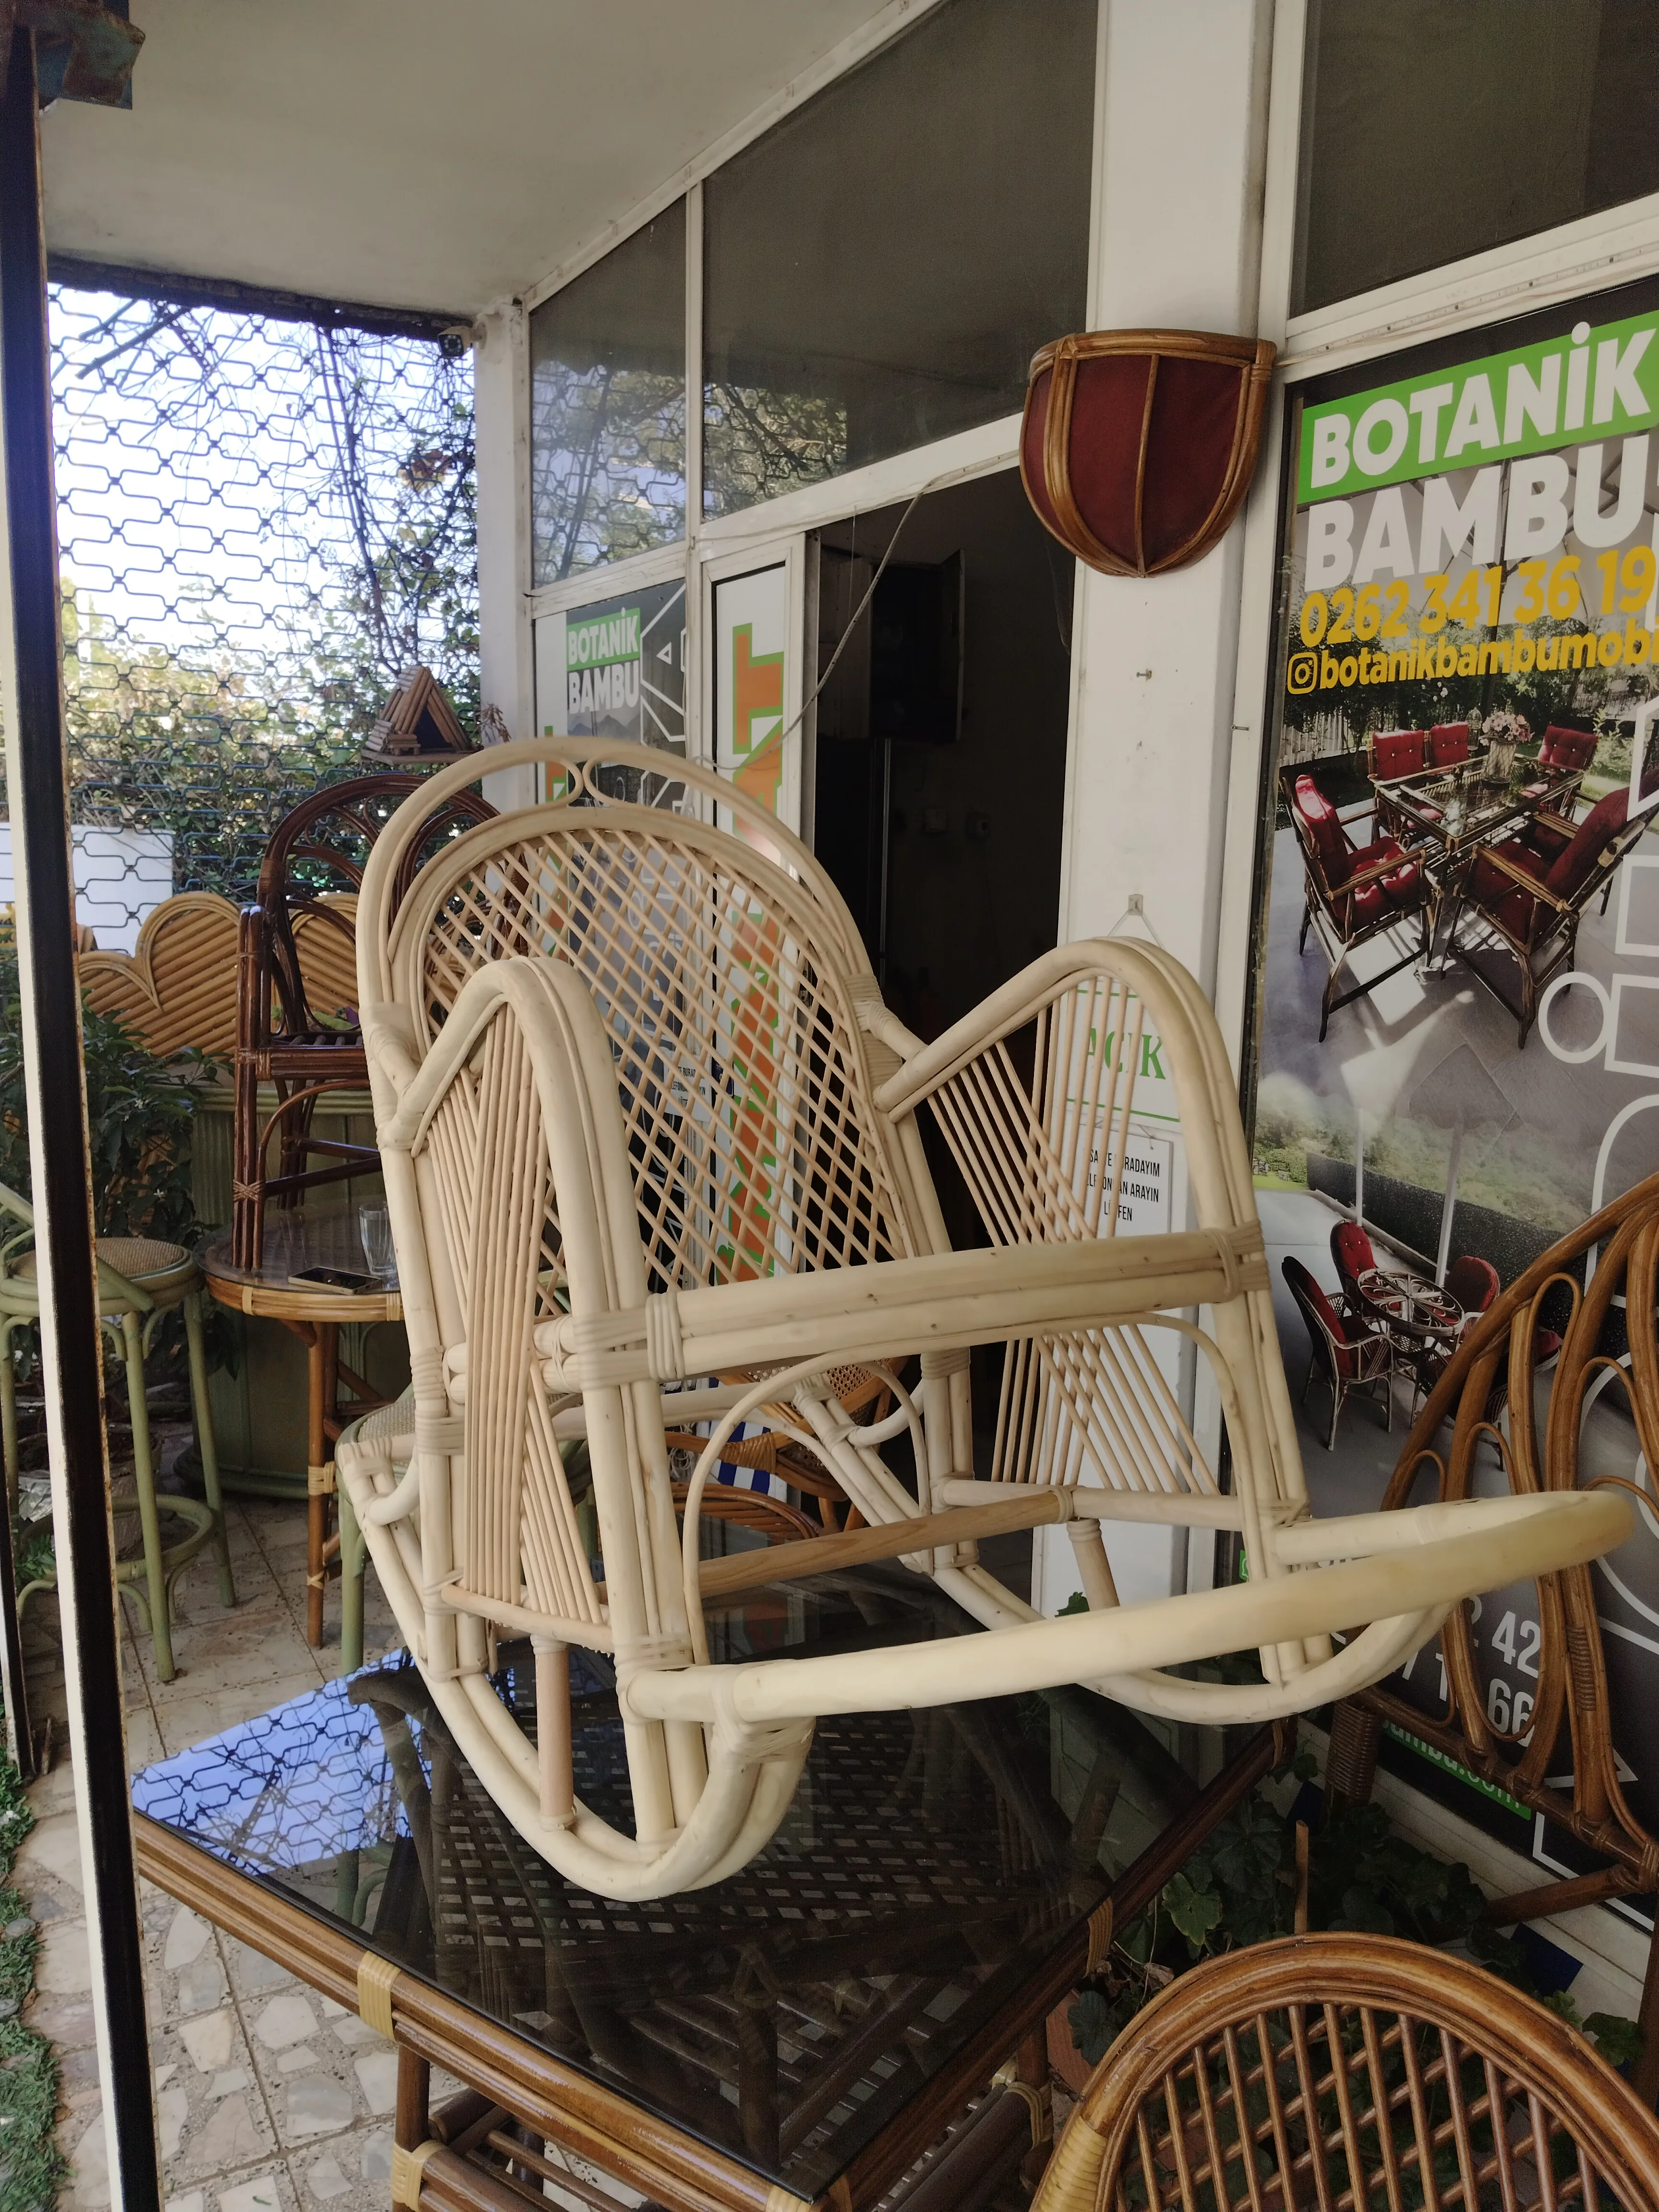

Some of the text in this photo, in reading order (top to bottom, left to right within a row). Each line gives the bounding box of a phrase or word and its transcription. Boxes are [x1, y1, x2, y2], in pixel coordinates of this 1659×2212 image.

[1310, 321, 1657, 489] BOTANİK
[1304, 434, 1650, 592] BAMBU
[568, 607, 639, 665] BOTANİK
[1299, 545, 1656, 648] 0262 341 36 19
[569, 660, 639, 714] BAMBU
[1130, 1183, 1159, 1202] ARAYIN
